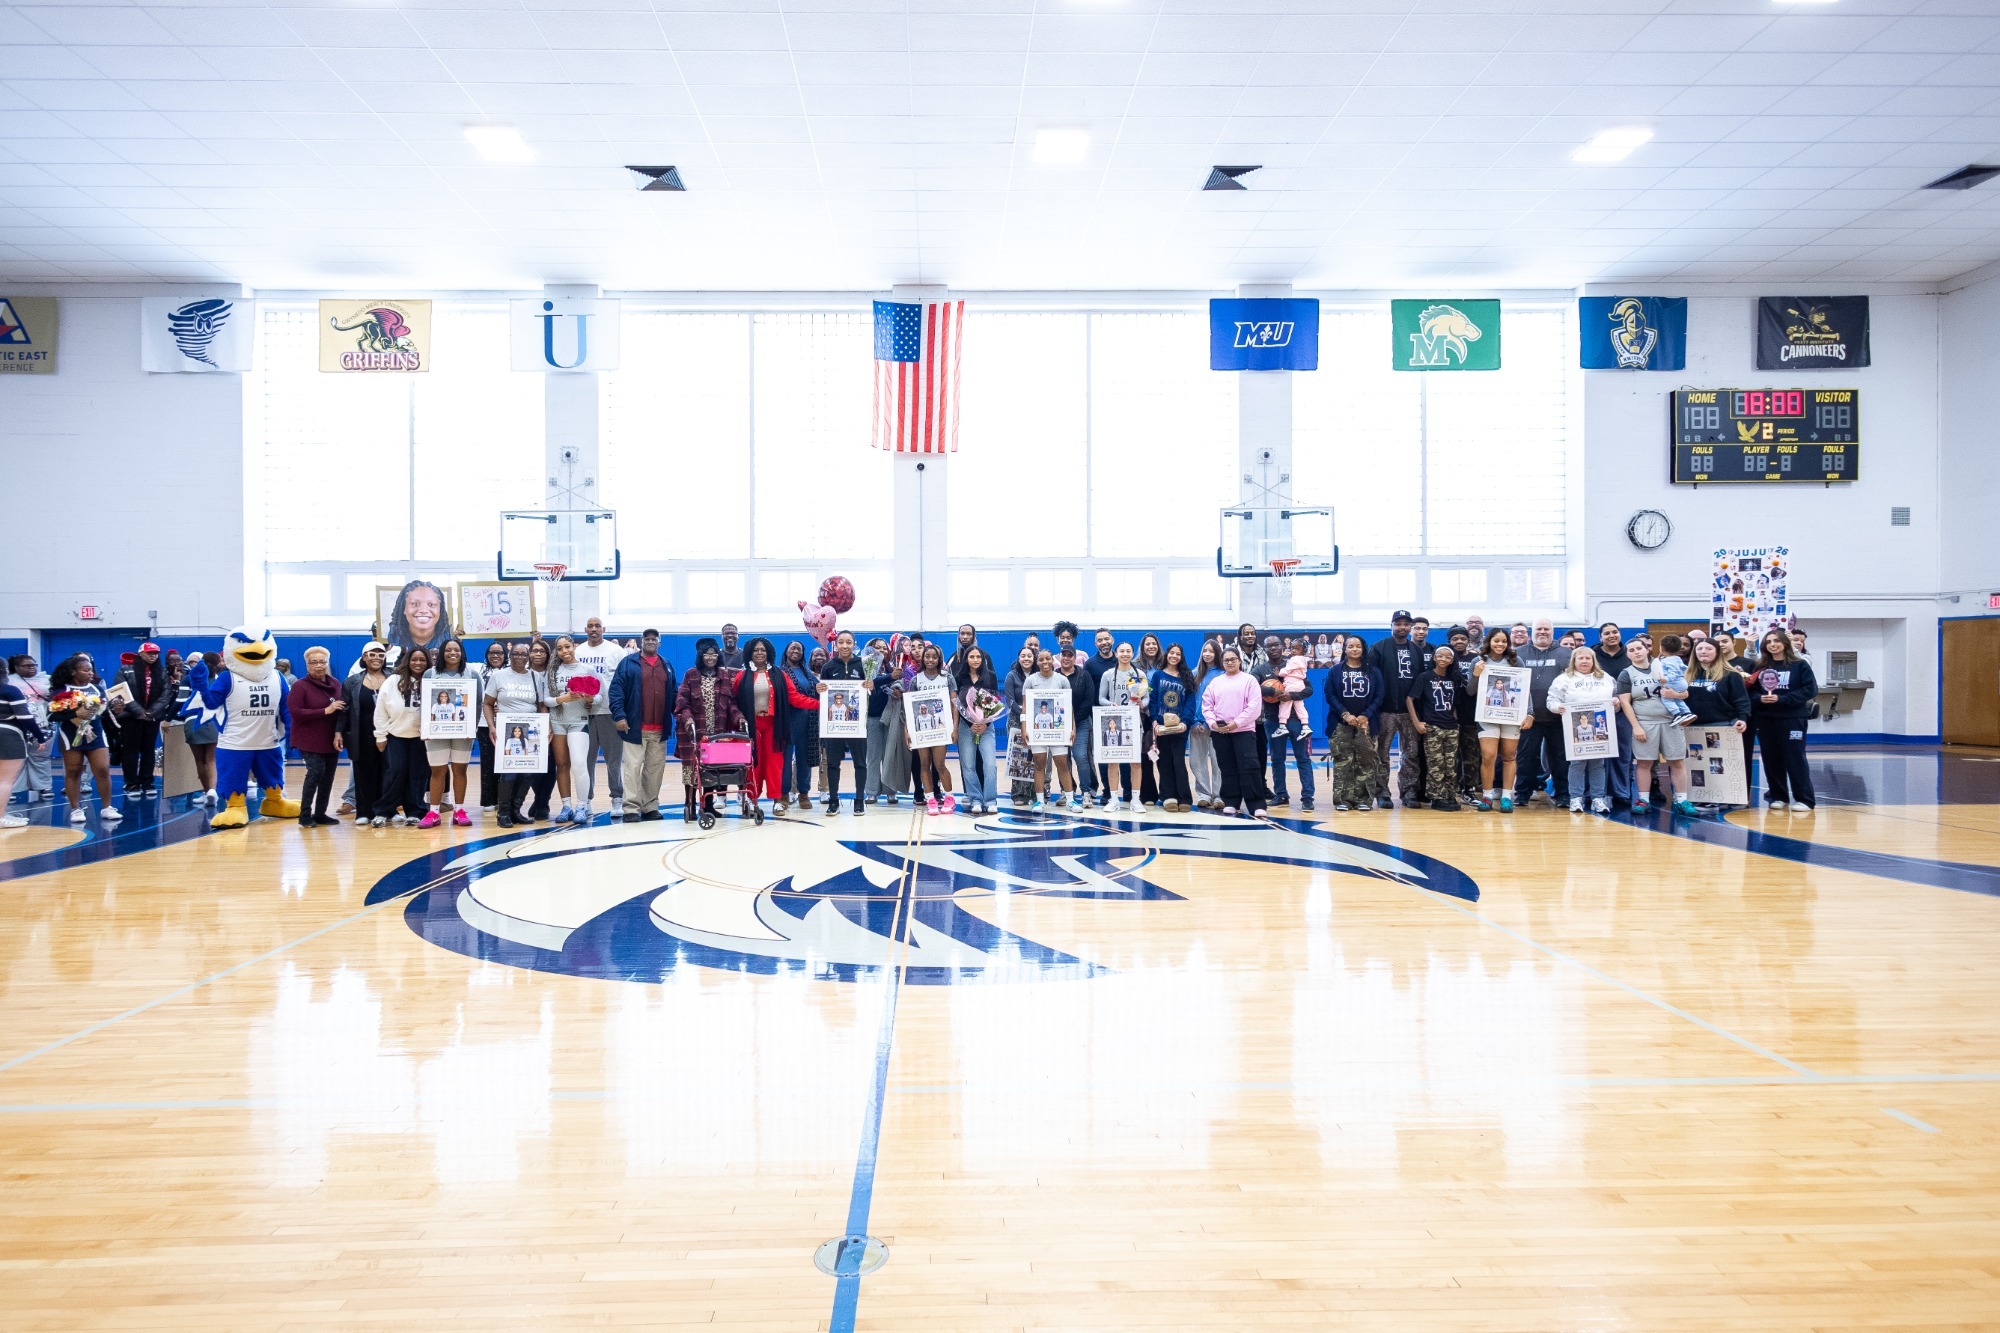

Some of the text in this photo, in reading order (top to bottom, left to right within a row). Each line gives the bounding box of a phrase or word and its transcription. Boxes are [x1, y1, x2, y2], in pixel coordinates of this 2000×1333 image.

[1233, 321, 1295, 347] MU
[18, 351, 47, 360] EAST
[1409, 333, 1450, 366] M
[1780, 344, 1846, 361] CANNONEERS
[340, 352, 420, 371] GRIFFINS
[1688, 393, 1717, 404] HOME
[1815, 392, 1852, 403] VISITOR
[1762, 422, 1774, 439] 2
[1713, 548, 1727, 558] 20
[1775, 546, 1789, 556] 26
[1745, 590, 1755, 598] 14
[81, 607, 95, 618] EXIT
[1343, 676, 1370, 697] 13
[1643, 686, 1661, 699] 14
[250, 694, 269, 707] 20
[1120, 693, 1128, 706] 2
